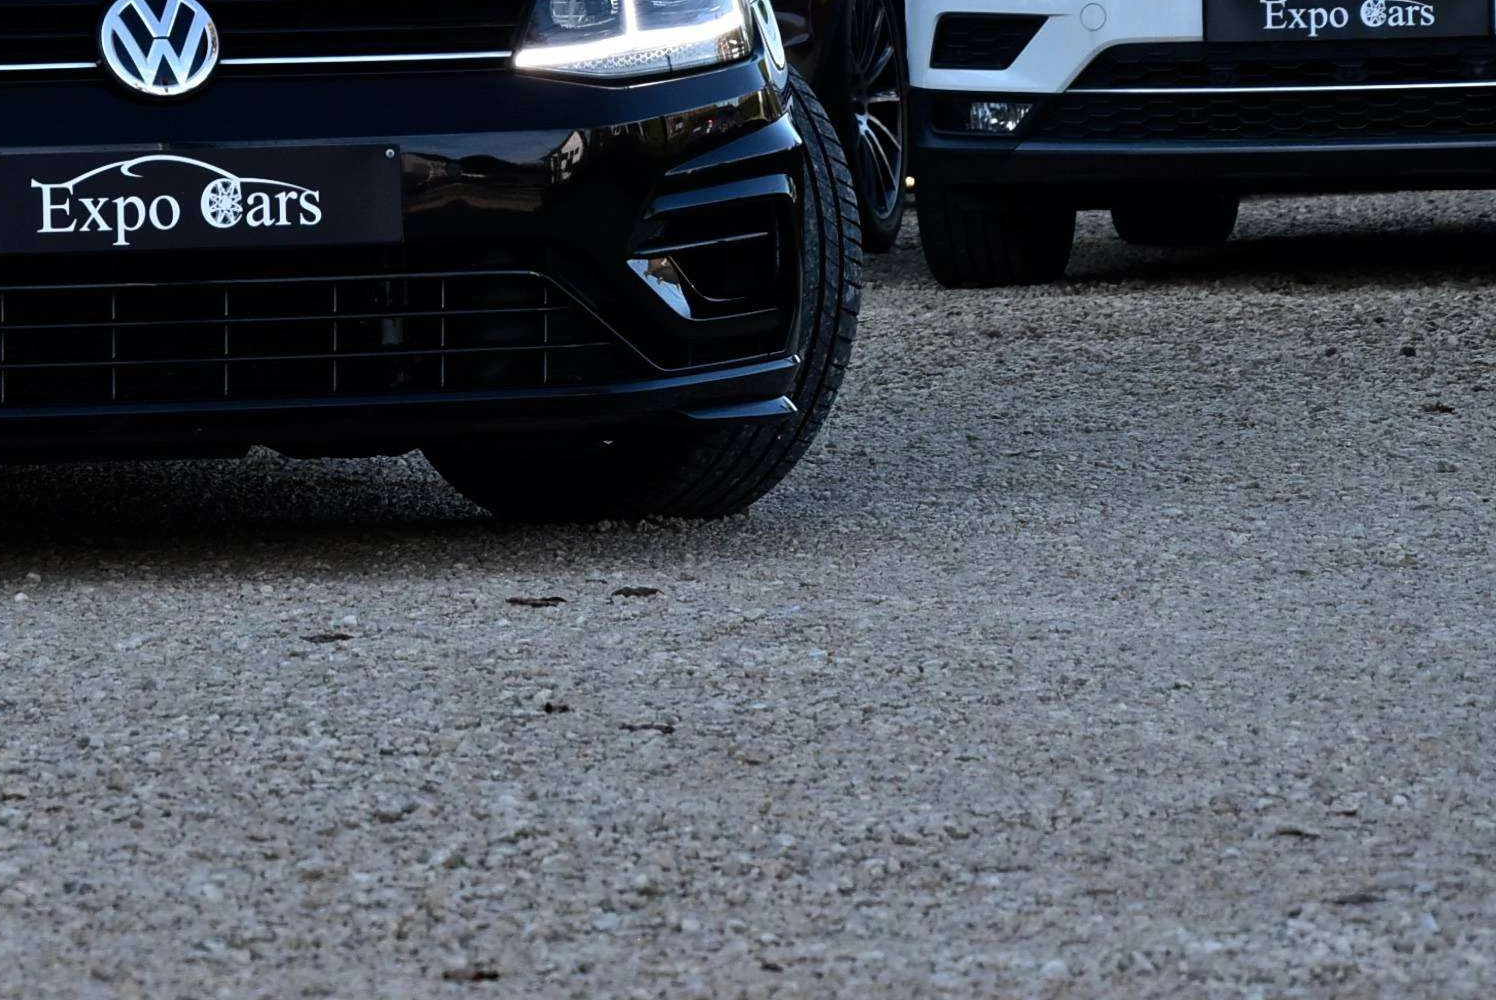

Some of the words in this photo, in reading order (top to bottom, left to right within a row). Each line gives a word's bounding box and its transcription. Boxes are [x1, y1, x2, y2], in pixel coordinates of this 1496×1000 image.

[1262, 0, 1349, 38] Expo
[35, 181, 181, 246] Expo
[201, 177, 322, 229] Cars
